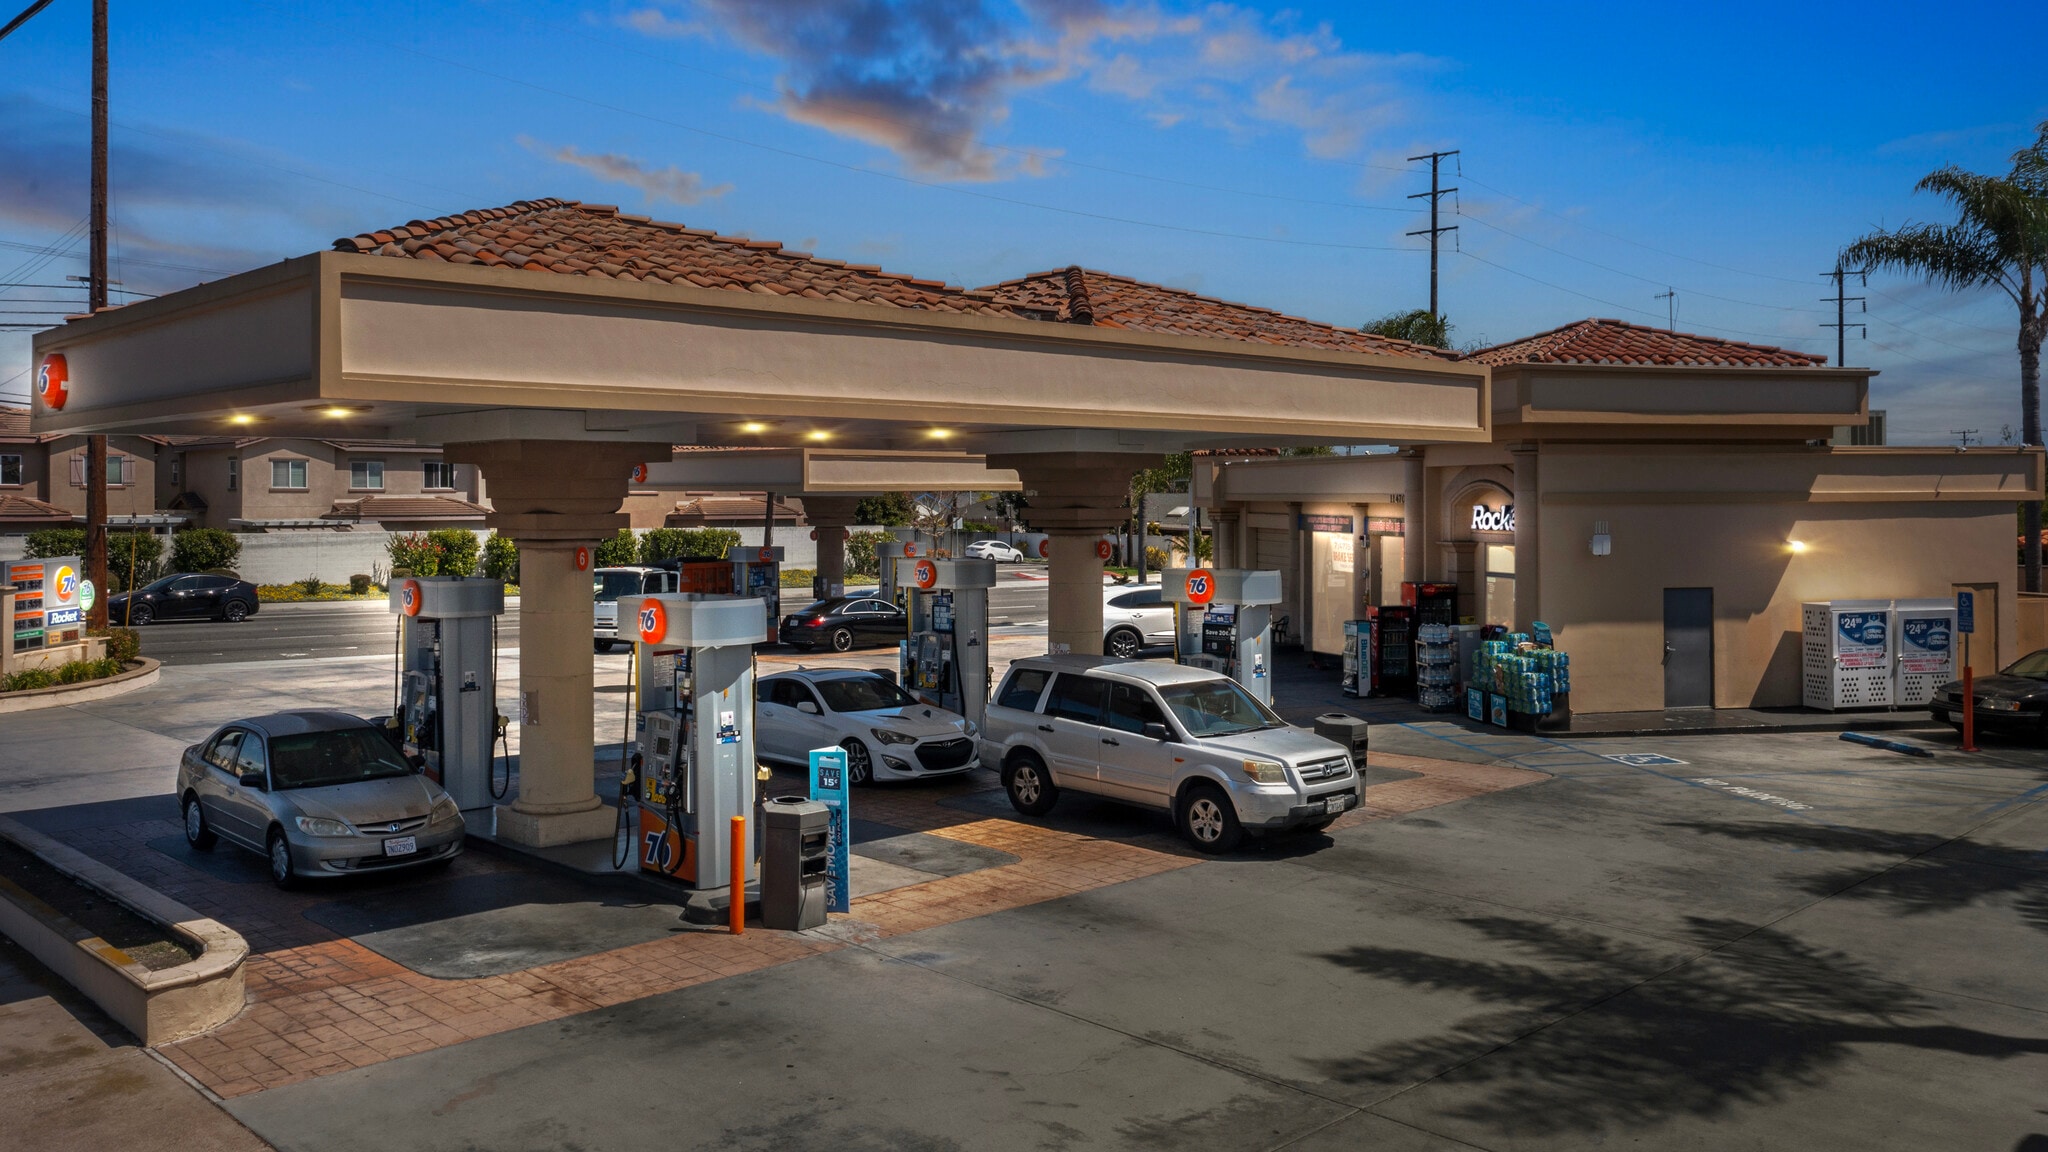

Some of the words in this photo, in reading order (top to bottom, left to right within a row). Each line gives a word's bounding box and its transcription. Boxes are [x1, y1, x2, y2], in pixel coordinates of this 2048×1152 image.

[579, 551, 585, 566] 6
[1101, 545, 1107, 555] 2
[62, 574, 76, 593] 76
[917, 568, 928, 581] 76
[1189, 576, 1207, 595] 76
[402, 588, 413, 607] 76
[51, 611, 78, 624] Rocket
[639, 608, 657, 633] 76
[819, 768, 841, 778] SAVE
[823, 777, 838, 787] 15¢
[644, 830, 672, 865] 76
[826, 825, 836, 867] MORE
[826, 870, 836, 907] SAVE
